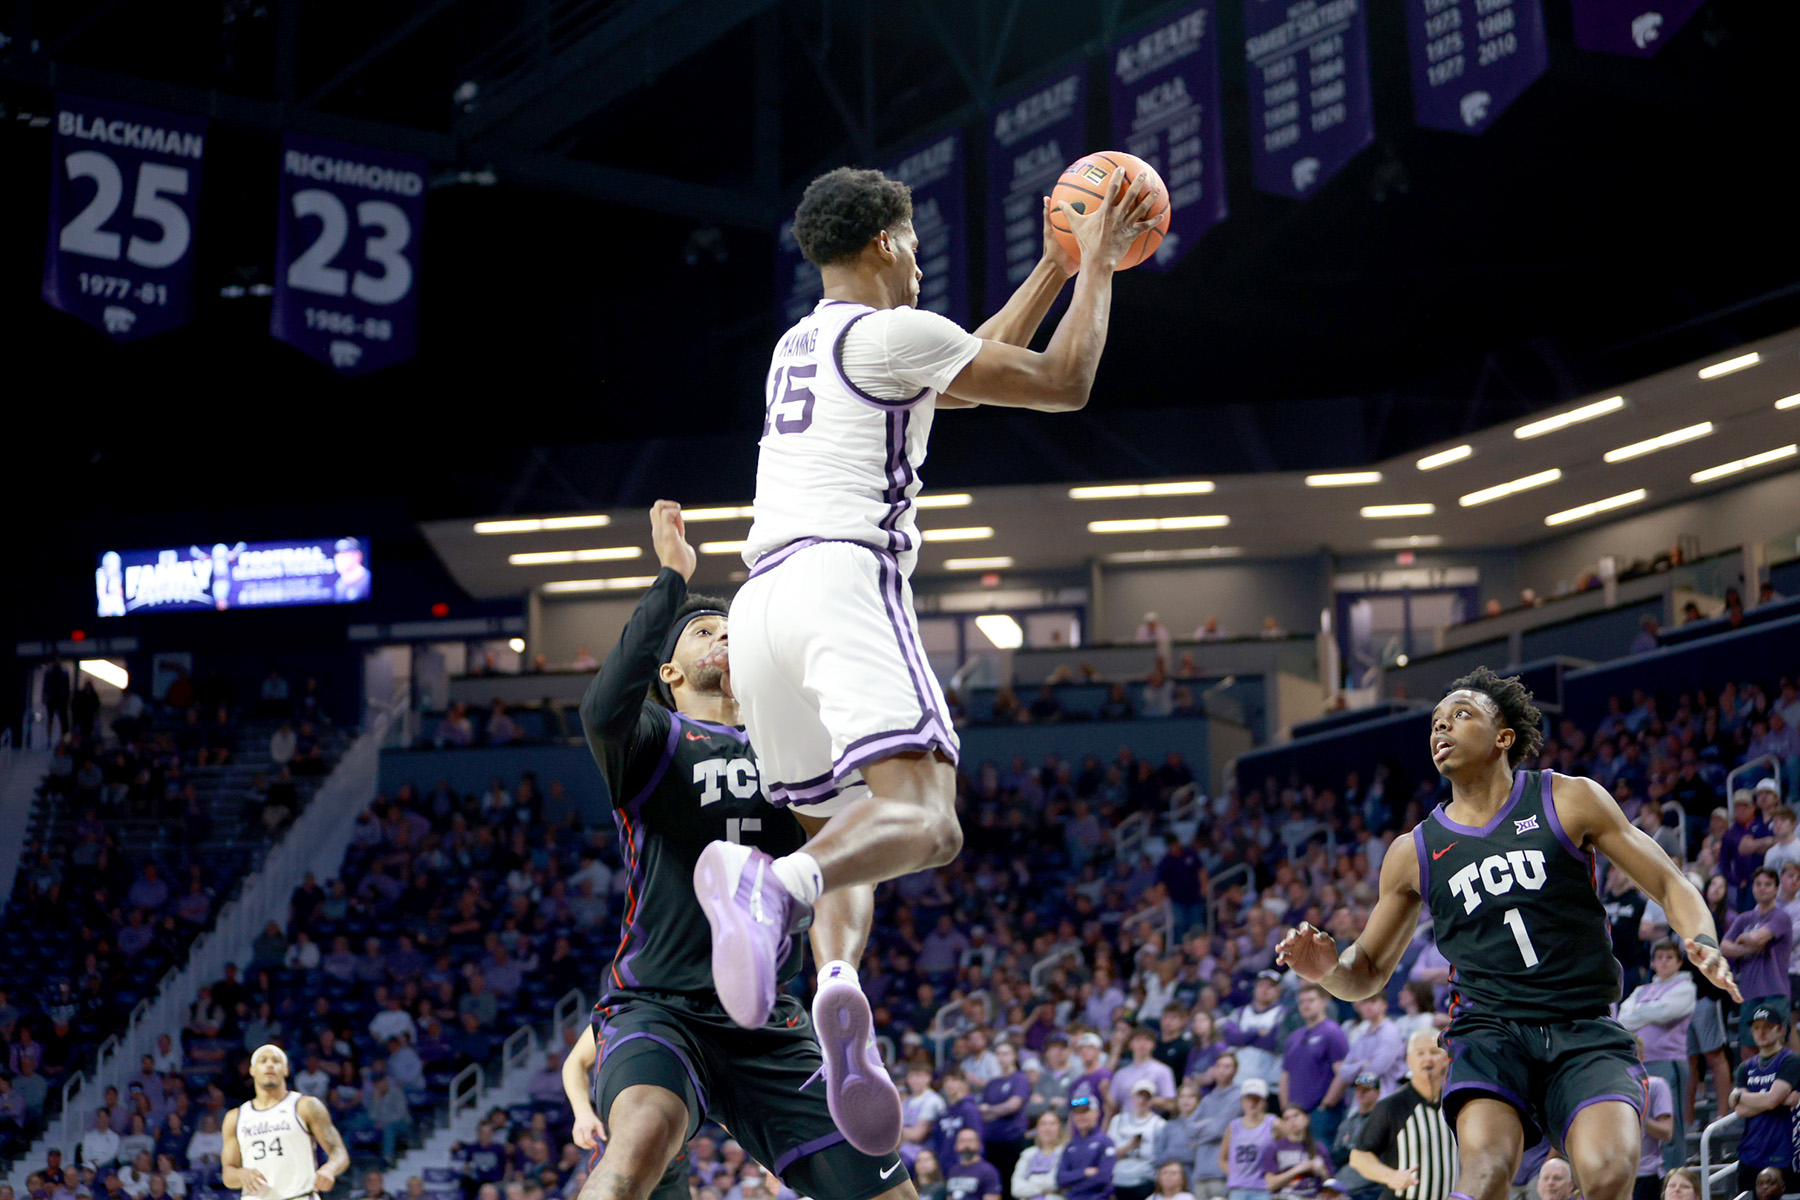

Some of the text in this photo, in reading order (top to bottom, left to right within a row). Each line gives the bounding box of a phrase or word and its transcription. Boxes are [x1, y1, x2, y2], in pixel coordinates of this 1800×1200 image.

[1478, 32, 1518, 66] 2010
[57, 111, 203, 159] BLACKMAN
[283, 150, 424, 197] RICHMOND
[59, 150, 192, 269] 25
[287, 188, 413, 305] 23
[79, 272, 168, 306] 1977-81
[305, 307, 392, 341] 1986-88
[1447, 850, 1547, 916] TCU
[1503, 907, 1540, 969] 1
[251, 1136, 284, 1160] 34
